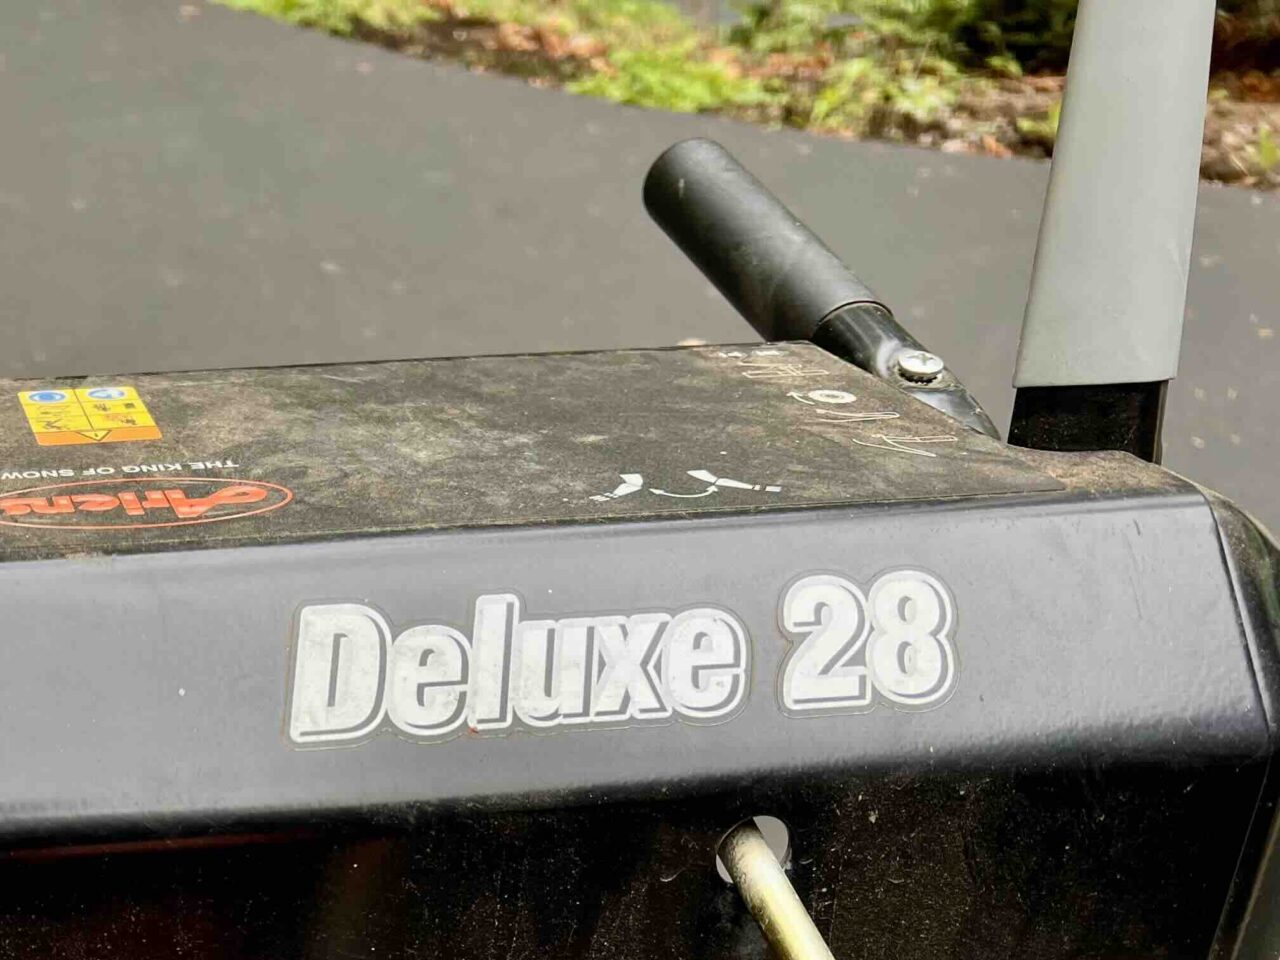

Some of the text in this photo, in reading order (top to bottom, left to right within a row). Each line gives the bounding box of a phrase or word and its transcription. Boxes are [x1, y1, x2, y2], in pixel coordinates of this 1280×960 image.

[121, 462, 183, 474] KING
[187, 459, 240, 470] THE
[81, 466, 116, 476] OF
[289, 570, 953, 743] Deluxe 28
